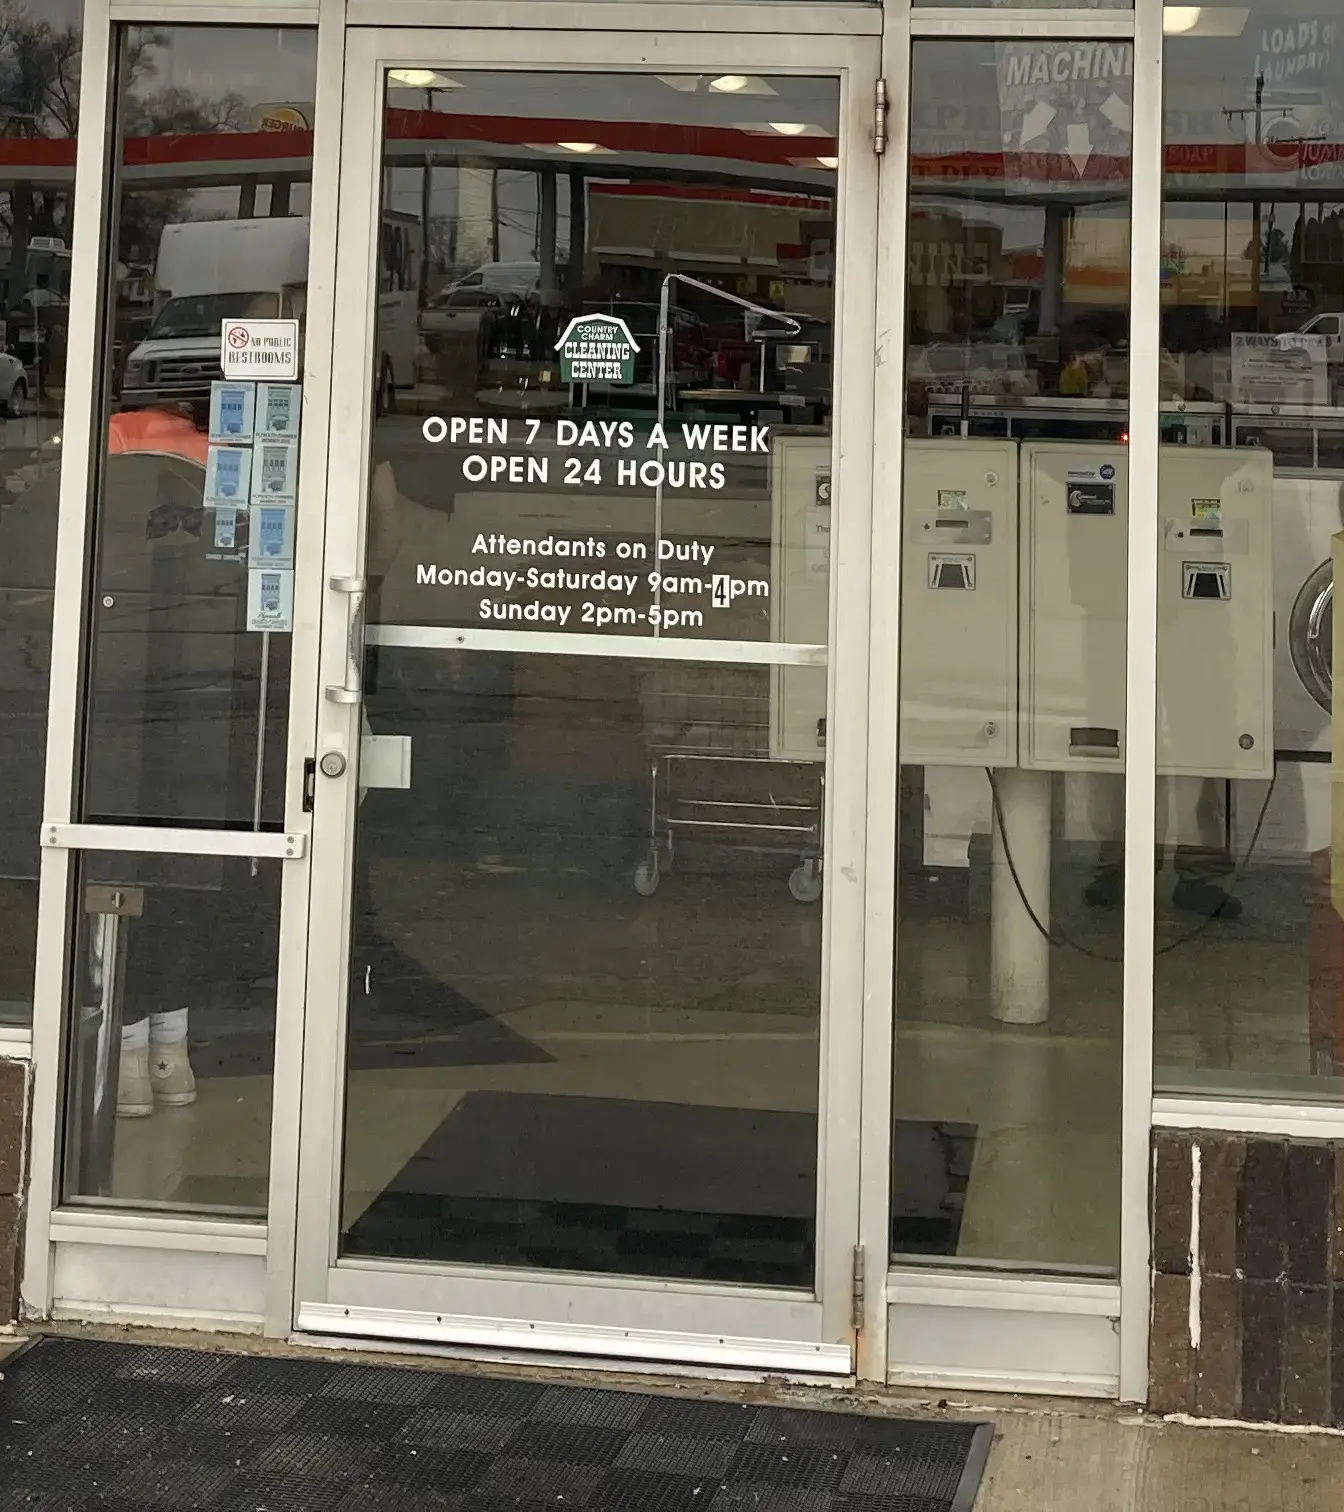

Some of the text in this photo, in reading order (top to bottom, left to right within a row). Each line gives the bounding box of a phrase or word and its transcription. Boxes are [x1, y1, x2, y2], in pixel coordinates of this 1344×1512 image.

[576, 325, 619, 334] COUNTRY
[580, 333, 614, 341] CHARM
[250, 336, 292, 348] NO PUBLIC
[564, 341, 630, 361] CLEANING
[228, 351, 292, 364] RESTROOMS
[571, 360, 623, 380] CENTER
[422, 416, 770, 453] OPEN 7 DAYS A WEEK
[462, 454, 726, 490] OPEN 24 HOURS
[471, 533, 715, 566] Attendants on Duty
[416, 564, 770, 608] Monday-Saturday 9am-4pm
[479, 598, 704, 630] Sunday 2pm-5pm
